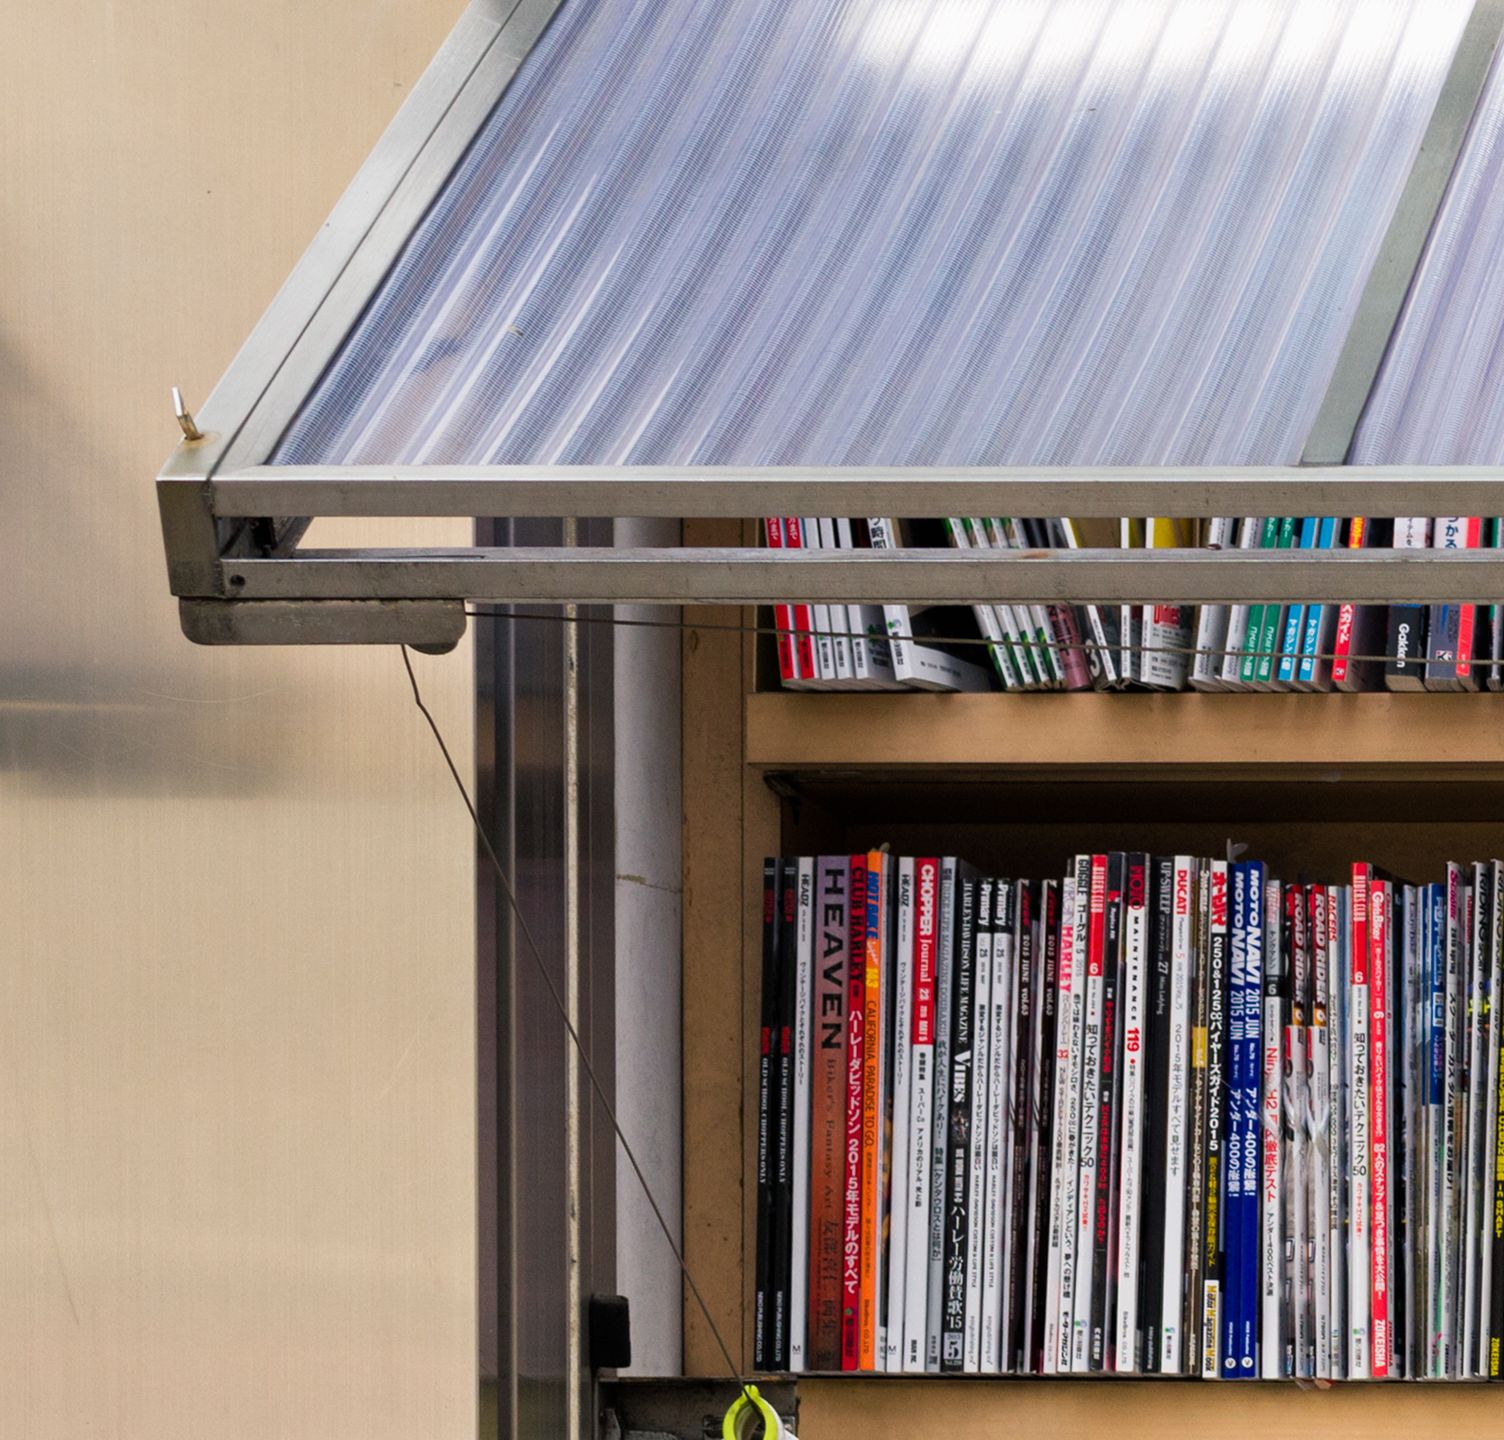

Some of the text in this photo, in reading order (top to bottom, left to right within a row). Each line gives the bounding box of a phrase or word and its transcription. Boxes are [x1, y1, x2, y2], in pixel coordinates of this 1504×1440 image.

[1396, 623, 1410, 667] Gakken
[920, 865, 933, 936] CHOPPER
[1175, 869, 1187, 915] DUCATI
[821, 869, 844, 1049] HEAVEN
